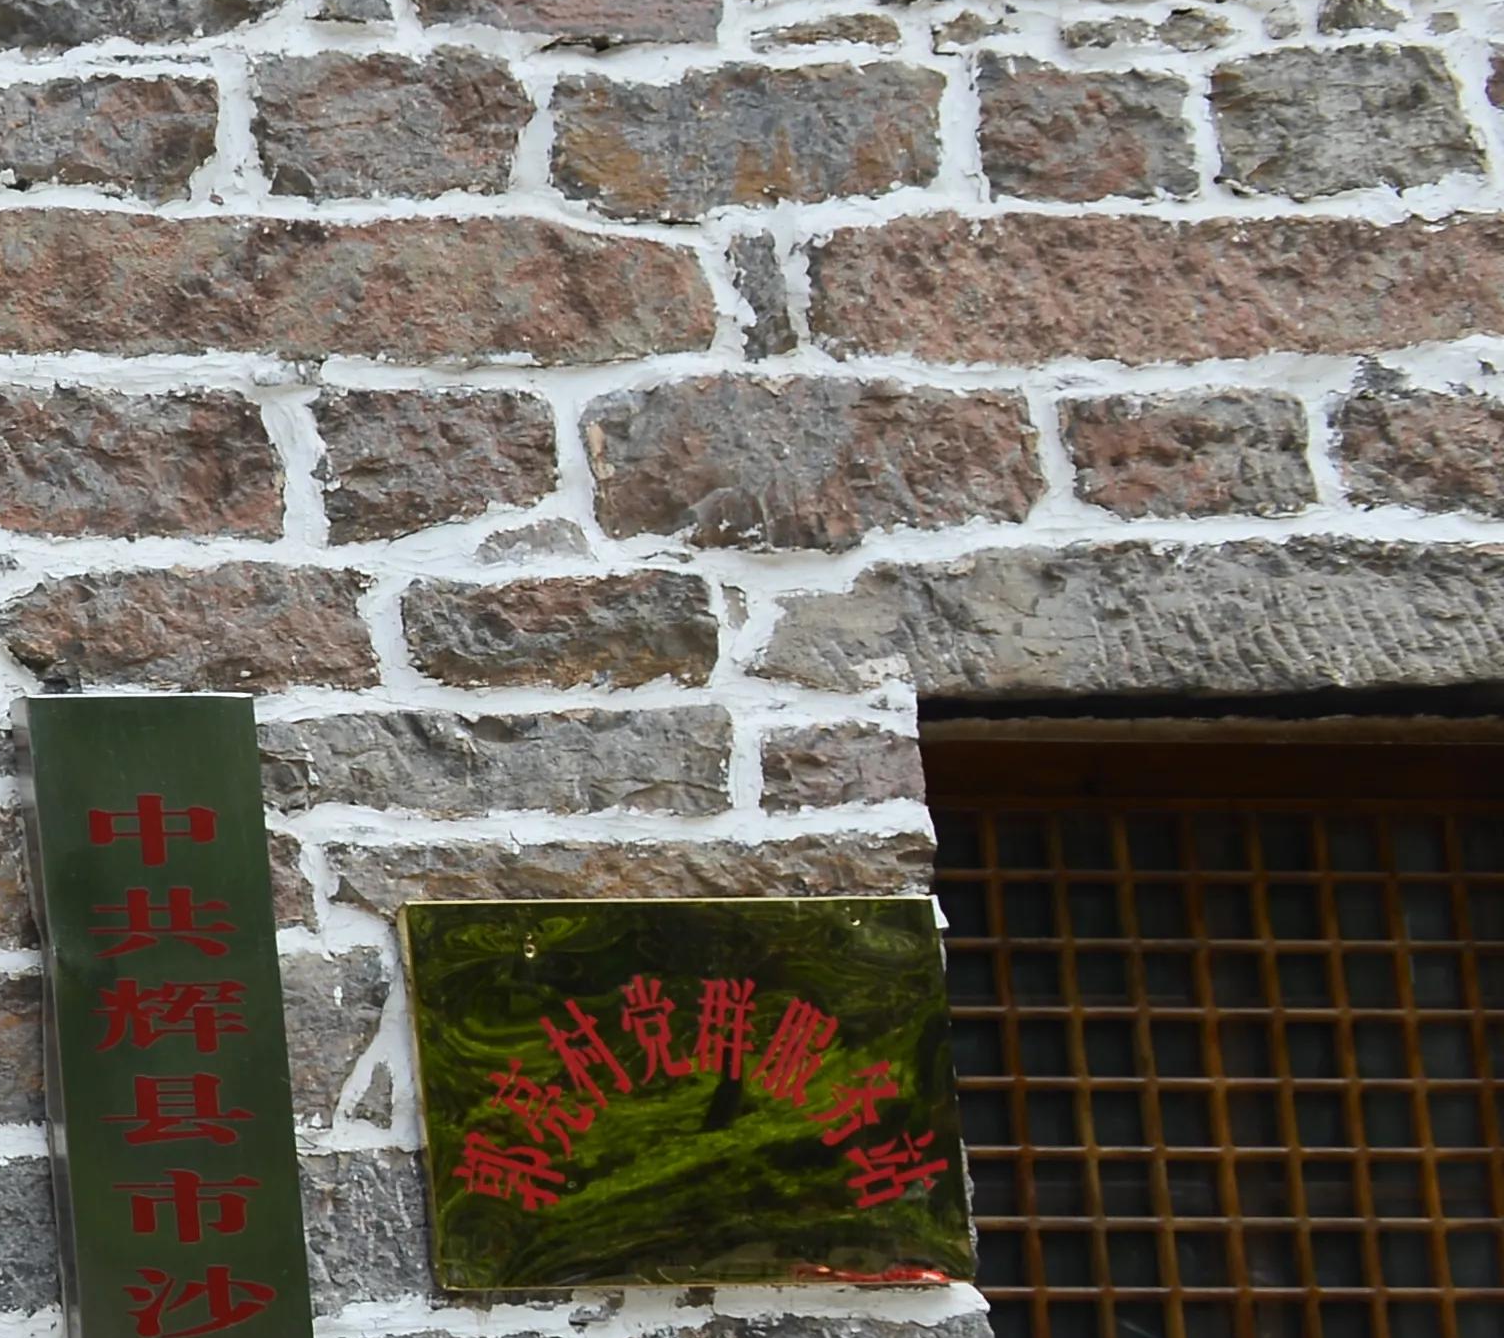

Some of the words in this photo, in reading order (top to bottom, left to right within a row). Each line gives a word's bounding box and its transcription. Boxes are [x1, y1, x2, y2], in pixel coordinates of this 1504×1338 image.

[453, 974, 948, 1211] 郭亮村党群服务站
